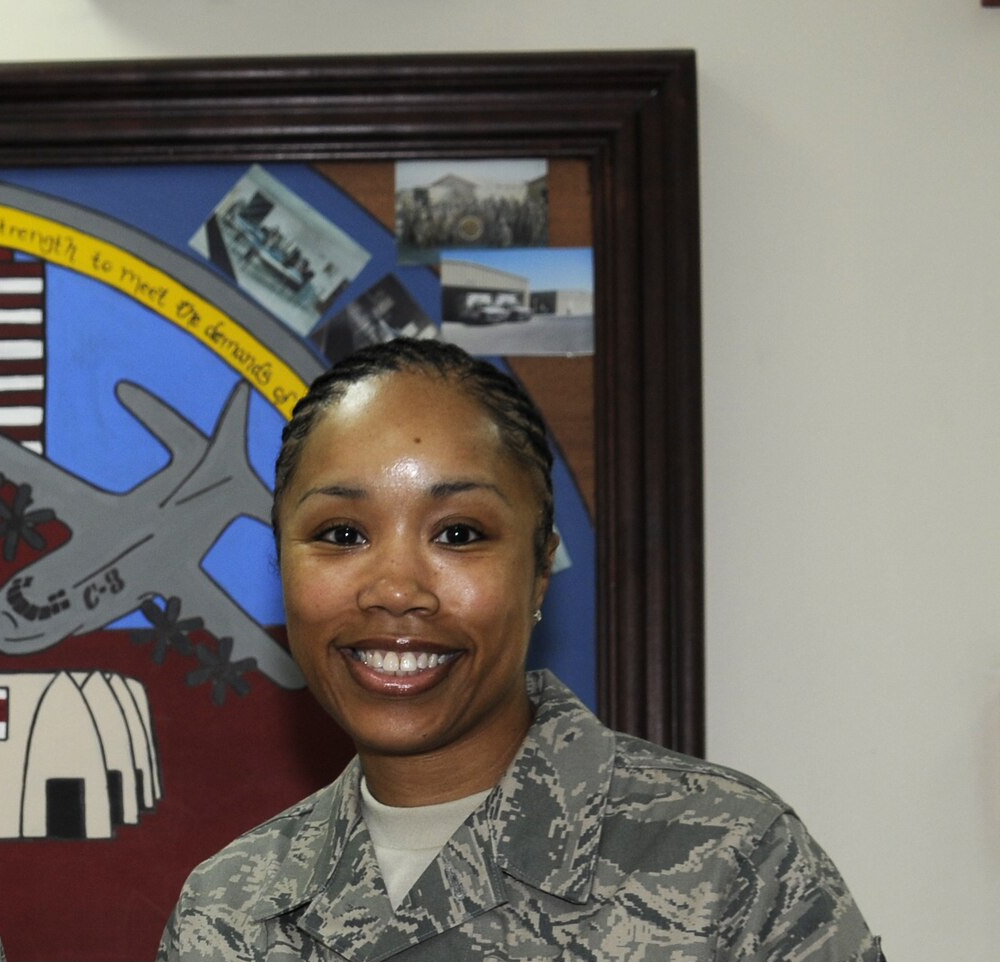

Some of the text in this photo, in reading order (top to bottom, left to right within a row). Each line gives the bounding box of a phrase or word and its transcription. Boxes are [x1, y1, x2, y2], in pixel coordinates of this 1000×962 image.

[92, 252, 112, 272] to
[120, 266, 168, 306] meet
[204, 321, 273, 385] demands
[273, 387, 297, 405] of
